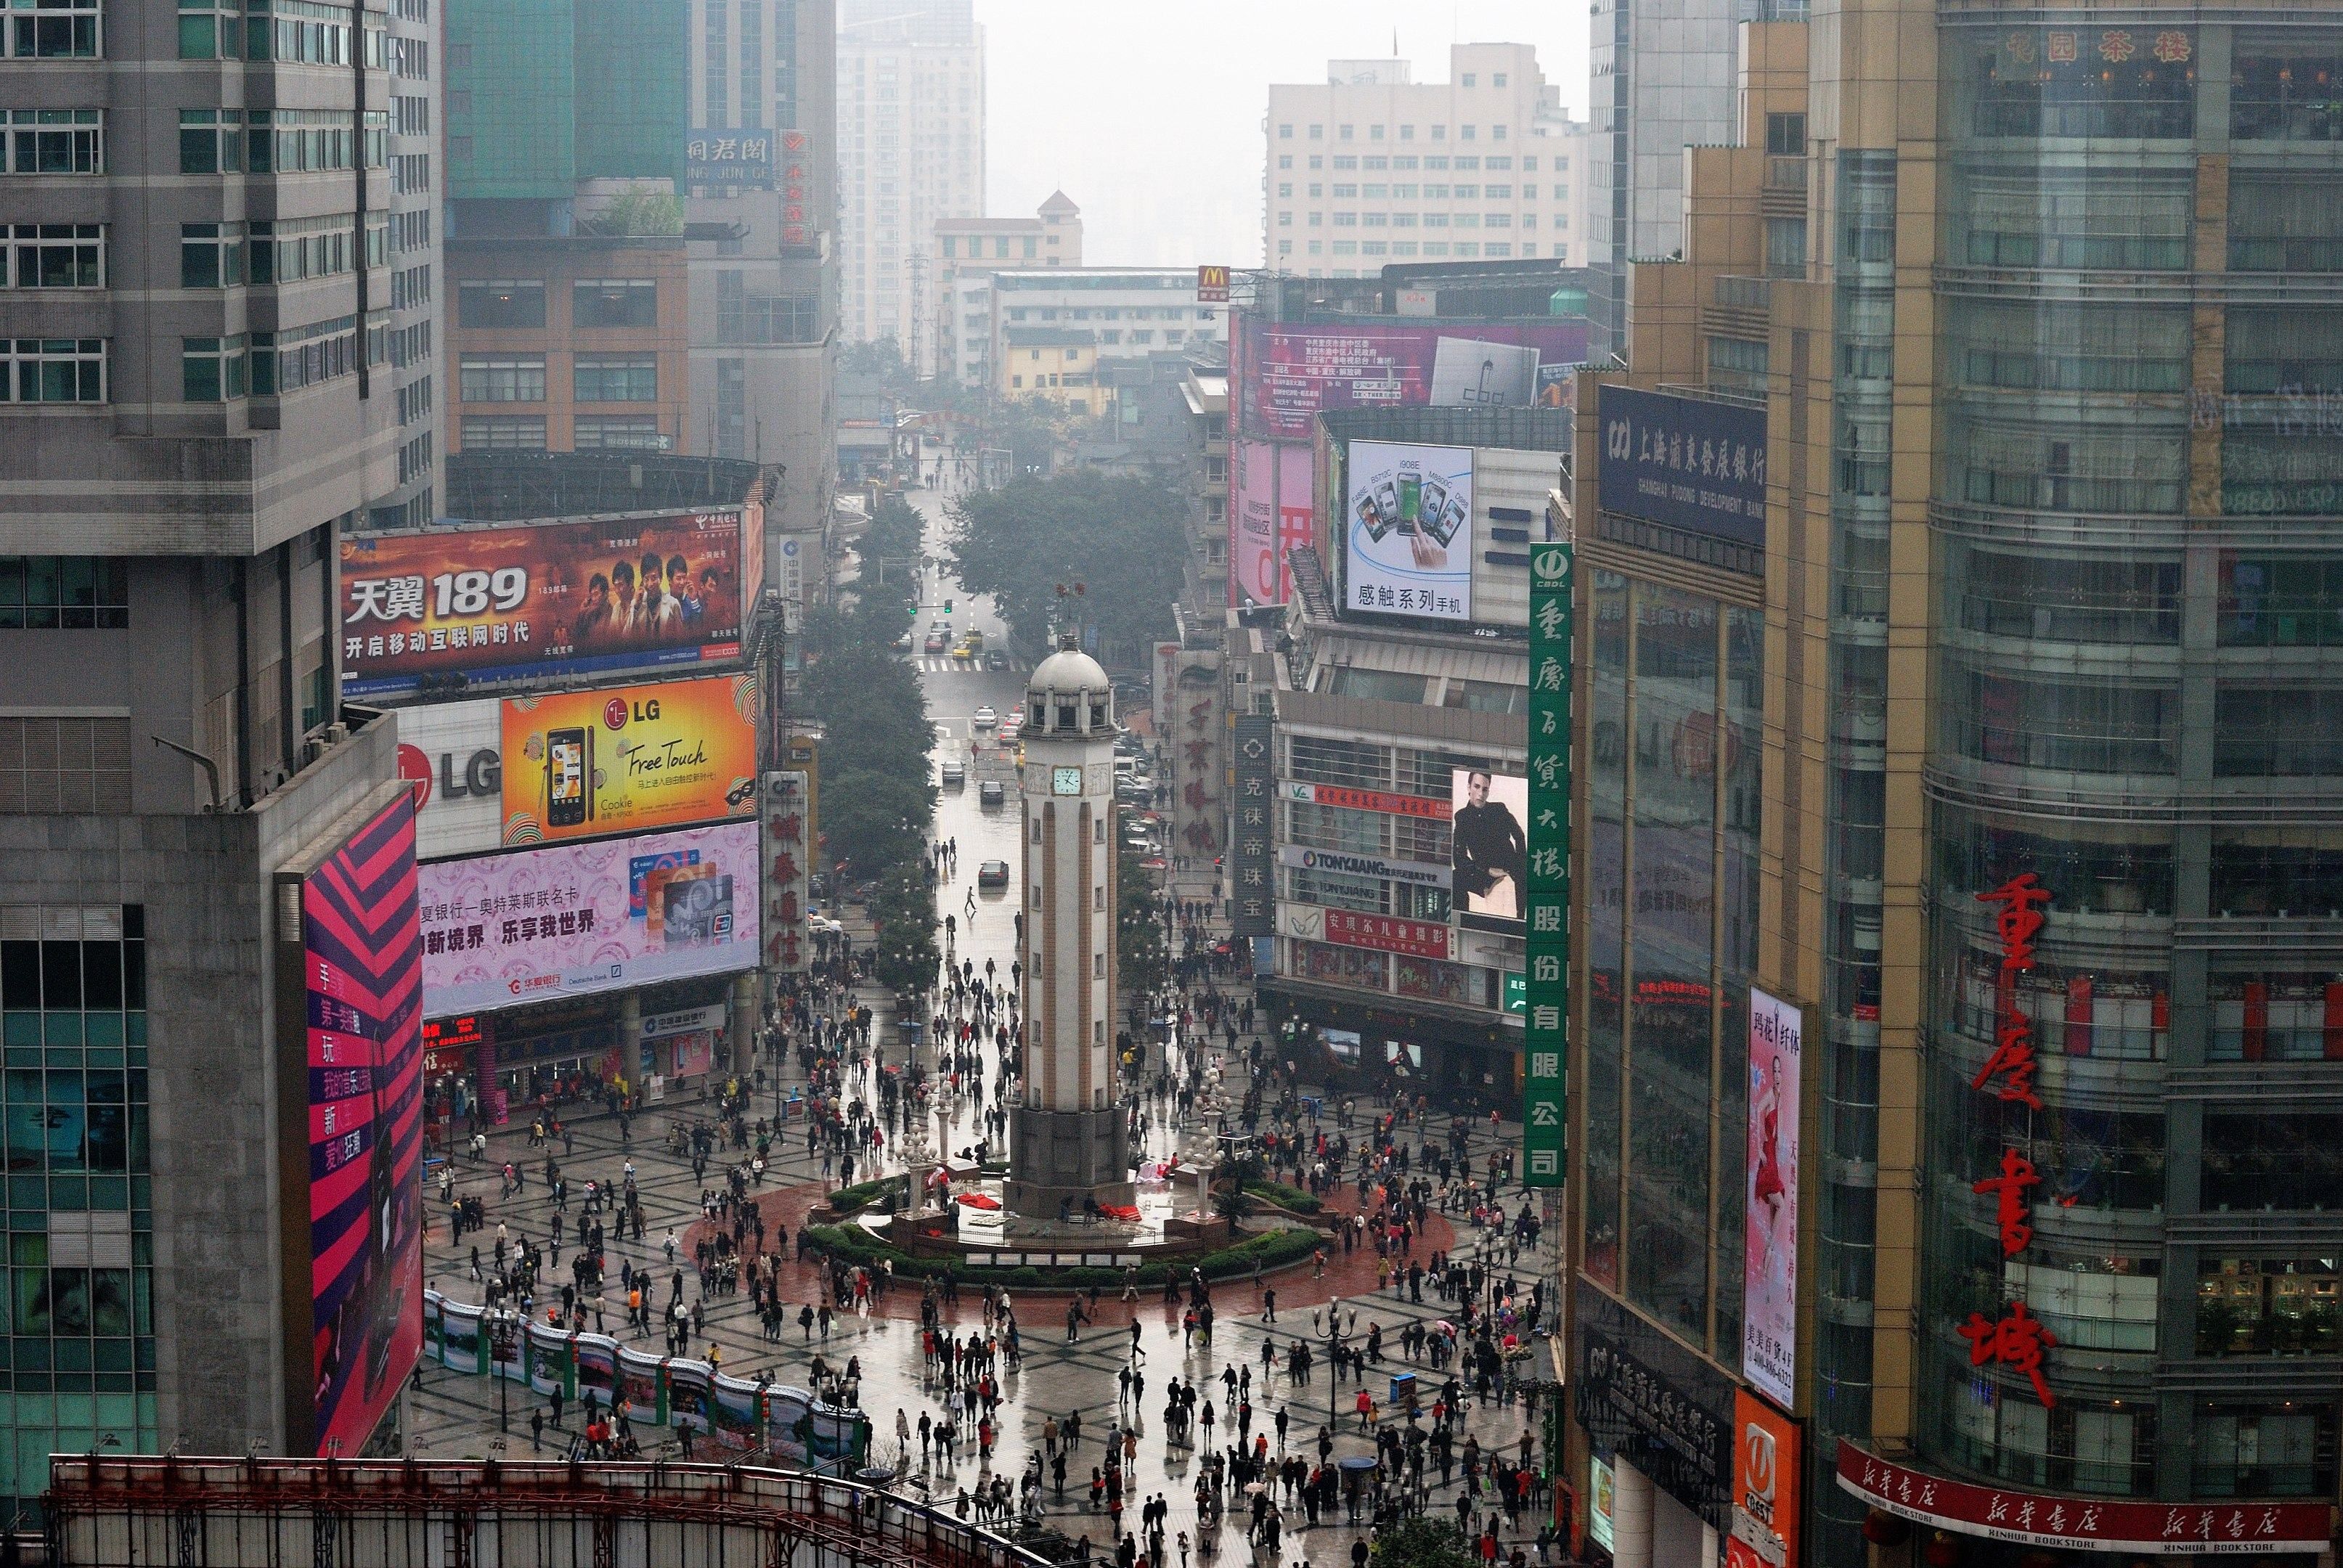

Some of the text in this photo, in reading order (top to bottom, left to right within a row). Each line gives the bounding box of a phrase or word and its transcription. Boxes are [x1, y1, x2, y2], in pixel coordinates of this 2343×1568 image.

[1400, 460, 1419, 469] i908E
[1638, 478, 1765, 520] SHANGHAI PUDONG DEVELOPMENT BANK
[346, 567, 527, 623] 天翼 189
[1358, 584, 1461, 613] 感触系列 手机
[346, 621, 529, 659] 开启移动互联网时代
[633, 699, 660, 722] LG
[441, 747, 502, 798] LG
[625, 739, 709, 777] Free Touch
[600, 798, 632, 811] Cookie
[1317, 853, 1385, 875] TONYJIANG
[501, 908, 595, 944] 乐享我世界
[524, 973, 561, 988] 华夏银行
[1863, 1493, 1934, 1524] XINHUA BOOKSTORE
[1988, 1528, 2097, 1550] XINHUA BOOKSTORE
[2164, 1543, 2275, 1553] XINHUA BOOKSTORE
